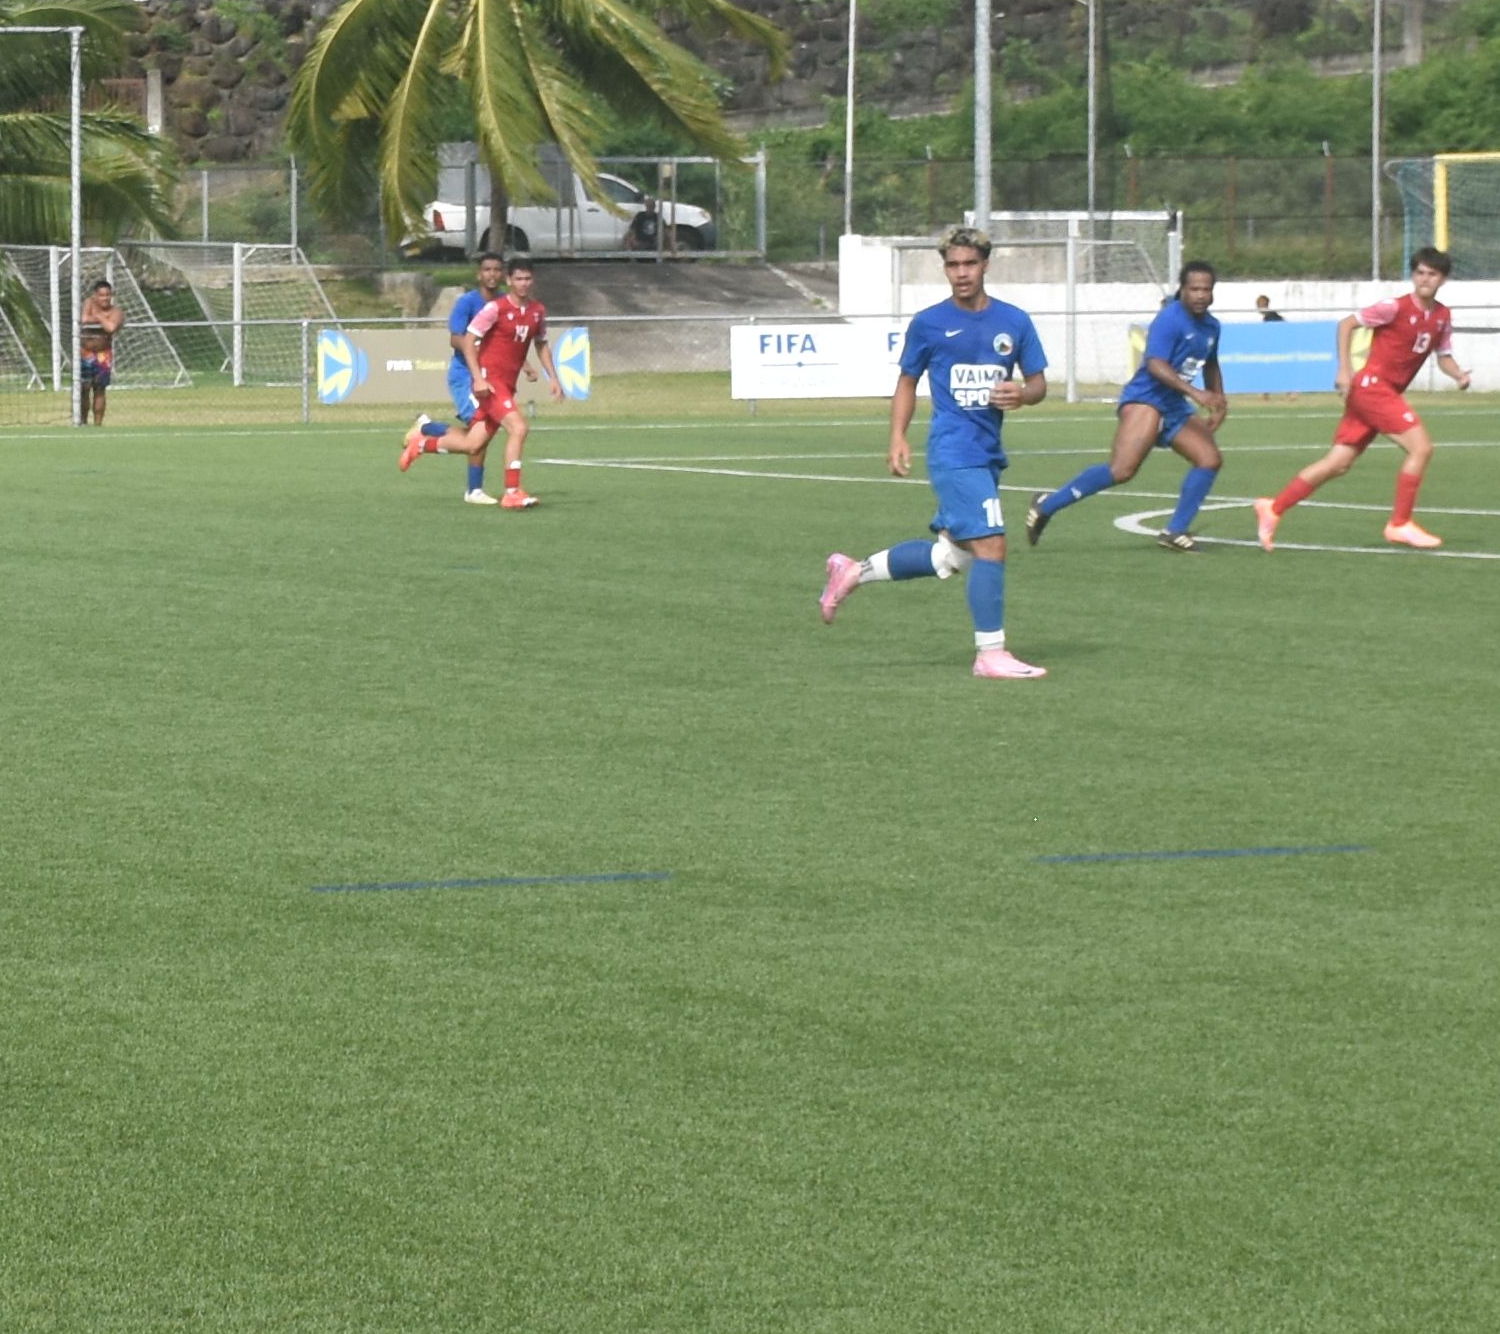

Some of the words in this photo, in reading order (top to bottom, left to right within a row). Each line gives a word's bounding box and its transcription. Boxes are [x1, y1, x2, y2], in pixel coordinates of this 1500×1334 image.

[514, 324, 530, 343] 14
[1411, 331, 1432, 354] 13
[760, 334, 817, 354] FIFA
[953, 389, 991, 407] SPO
